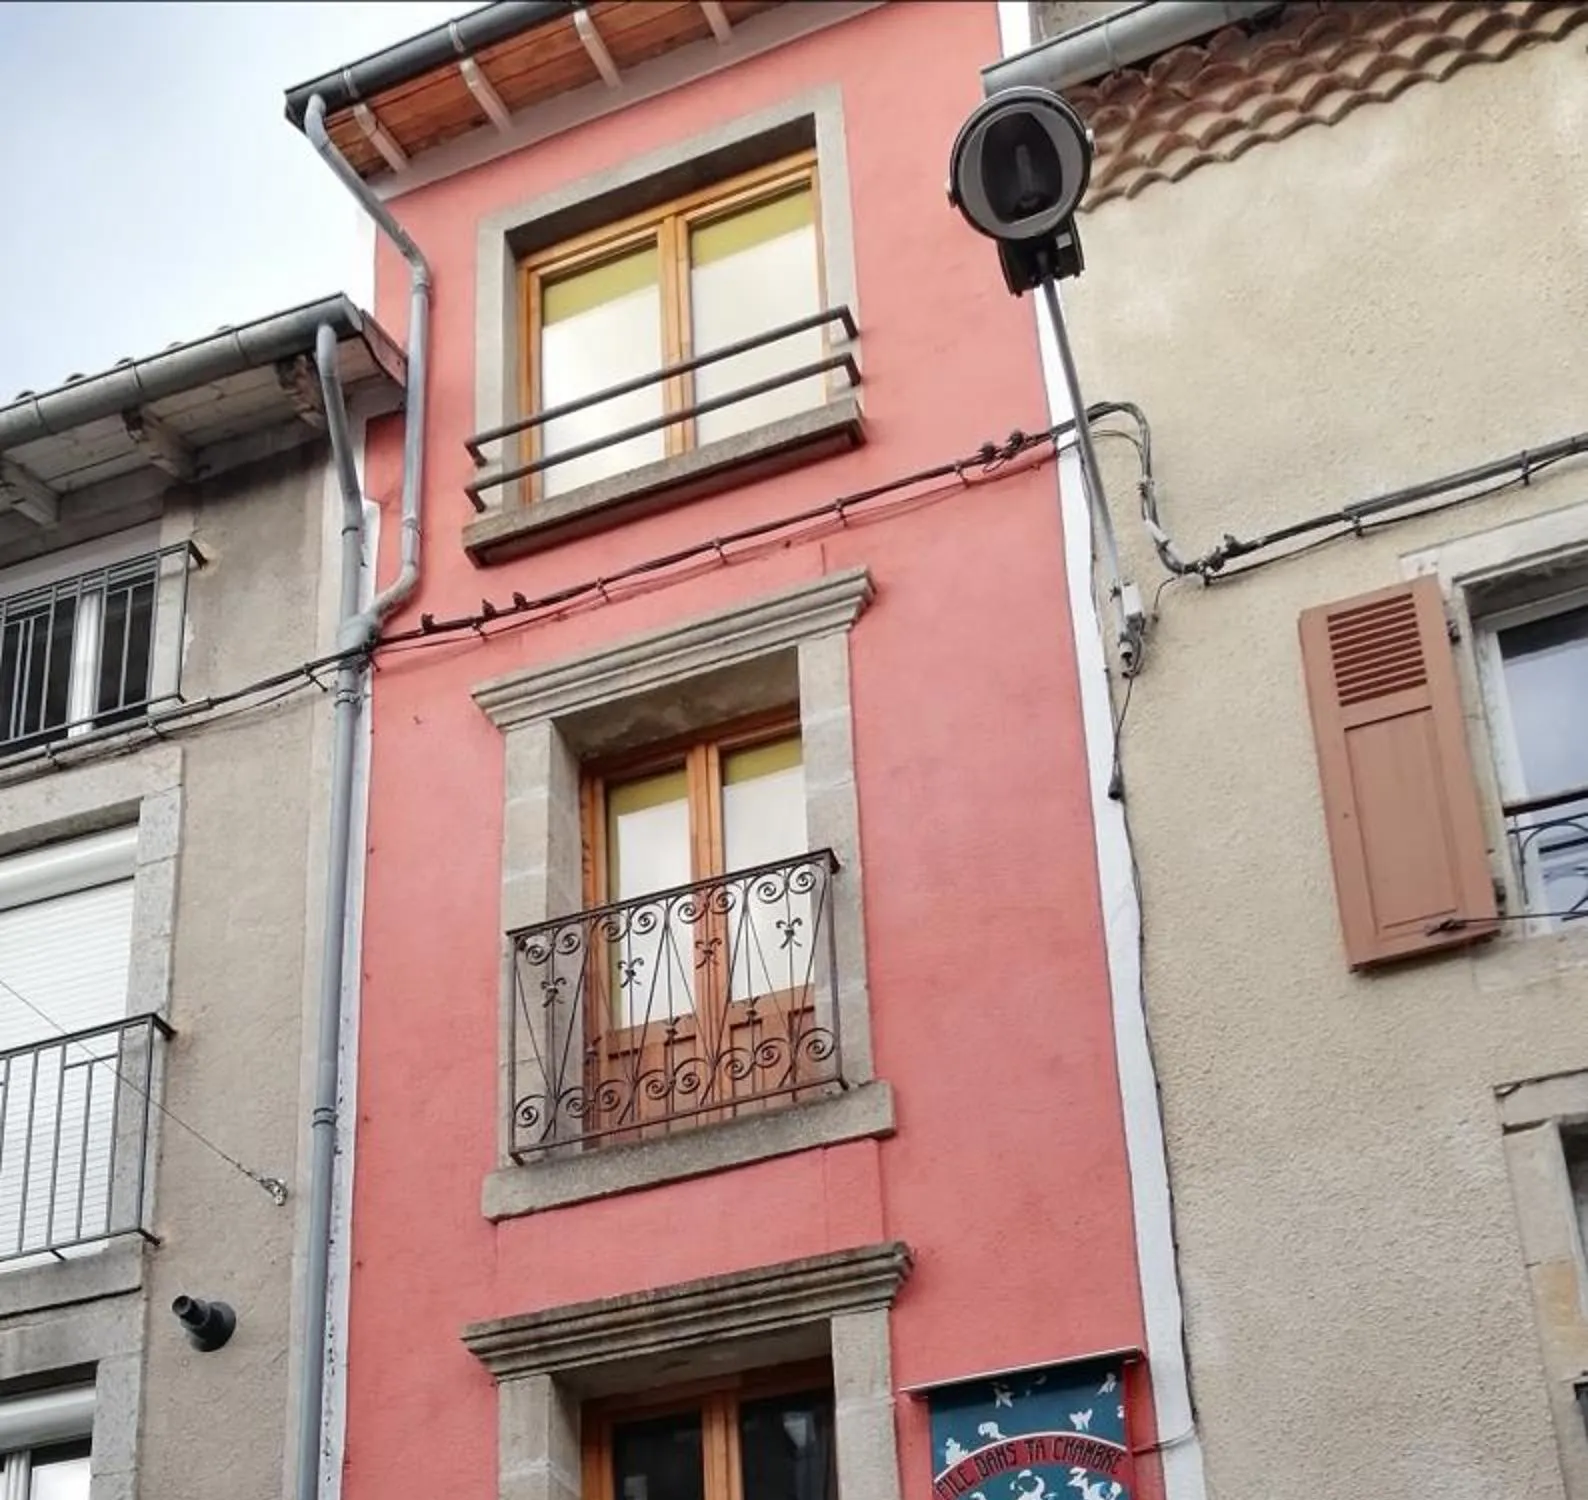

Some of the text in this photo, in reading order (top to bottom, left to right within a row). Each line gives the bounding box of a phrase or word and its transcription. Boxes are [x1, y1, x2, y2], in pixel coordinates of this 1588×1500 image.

[975, 1442, 1018, 1478] DANS
[1024, 1438, 1046, 1463] TA
[1053, 1436, 1125, 1475] CHAMBRE
